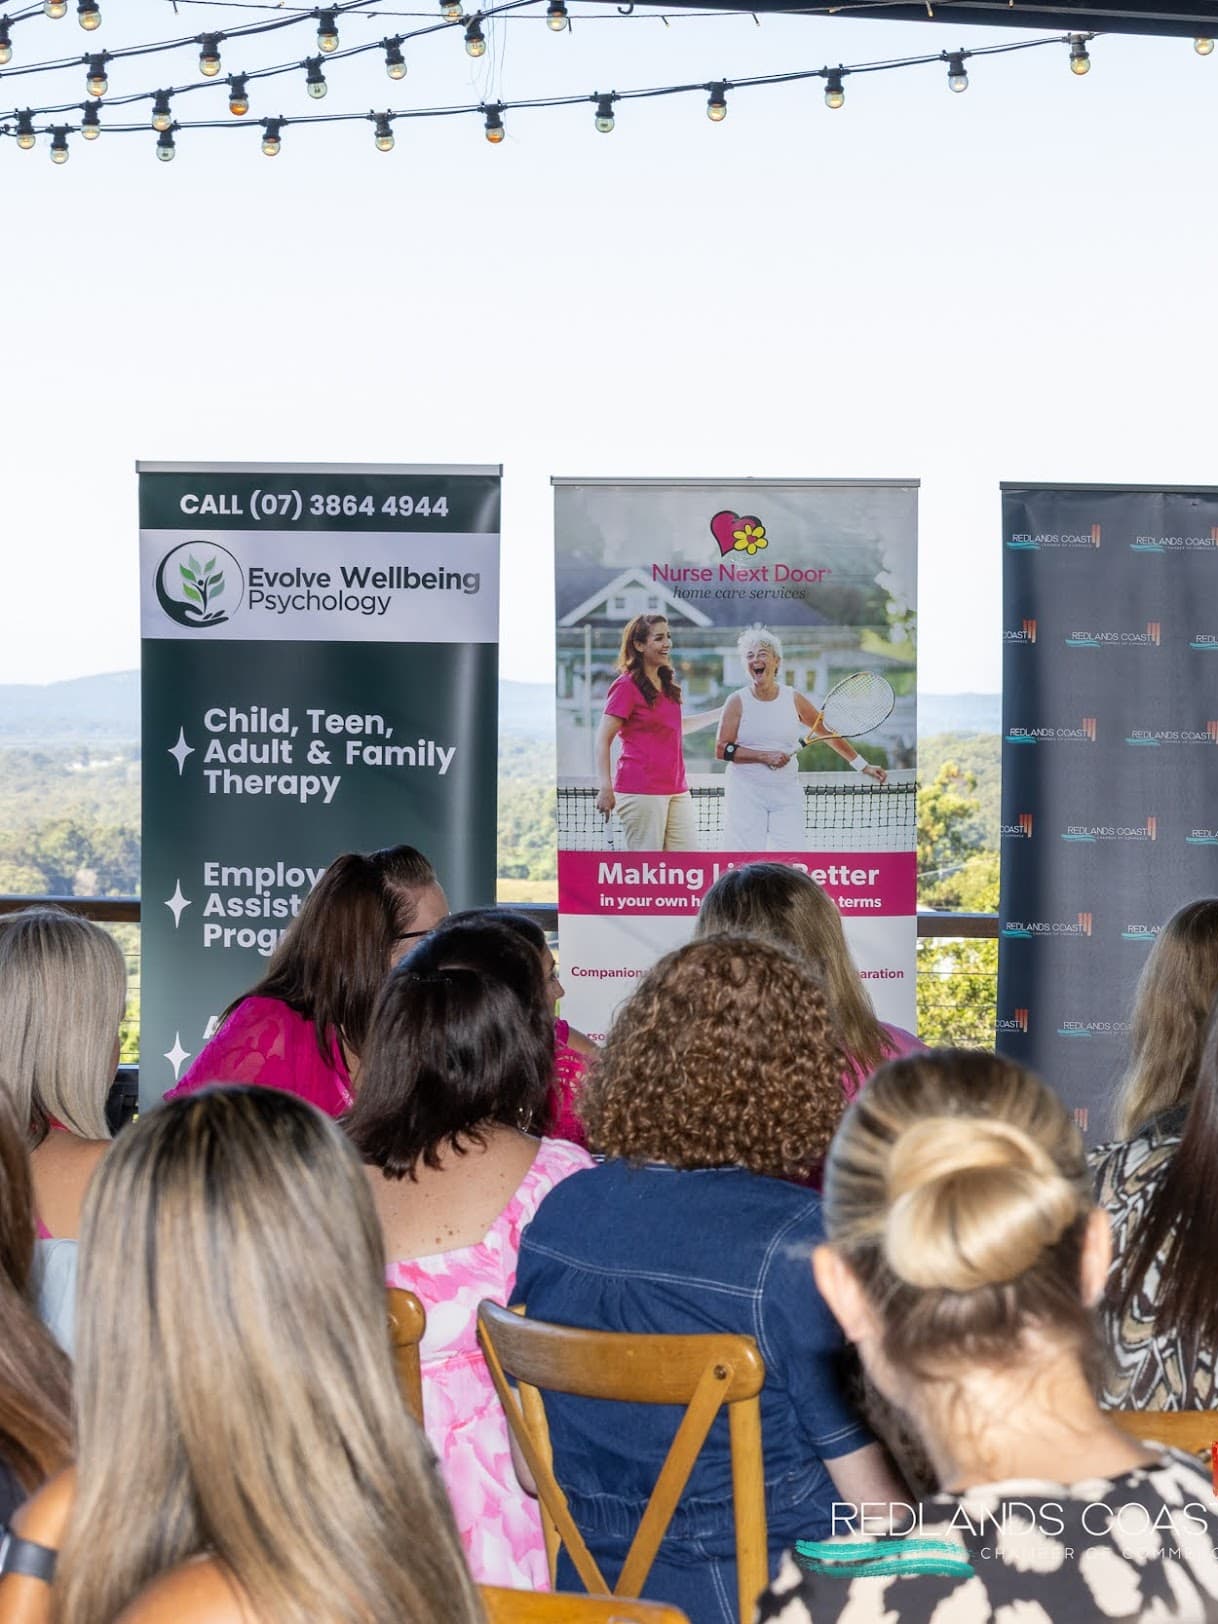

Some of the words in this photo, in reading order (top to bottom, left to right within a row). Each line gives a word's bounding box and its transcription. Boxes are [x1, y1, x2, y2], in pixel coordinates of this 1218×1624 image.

[179, 494, 243, 516] CALL
[249, 489, 302, 520] (07)
[310, 494, 375, 517] 3864
[381, 495, 449, 518] 4944
[1012, 533, 1058, 543] REDLANDS
[1060, 534, 1092, 544] COAST
[1136, 536, 1183, 546] REDLANDS
[1185, 537, 1217, 547] COAST
[248, 567, 331, 588] Evolve
[340, 566, 481, 595] Wellbeing
[652, 563, 713, 582] Nurse
[719, 563, 769, 583] Next
[774, 564, 827, 583] Door
[673, 585, 712, 599] home
[715, 588, 746, 600] care
[750, 586, 807, 600] services
[249, 590, 392, 615] Psychology
[1072, 631, 1119, 641] REDLANDS
[1121, 632, 1152, 642] COAST
[203, 706, 299, 737] Child,
[306, 709, 394, 738] Teen,
[1009, 728, 1054, 738] REDLANDS
[1056, 729, 1088, 738] COAST
[1132, 730, 1179, 740] REDLANDS
[1181, 731, 1212, 741] COAST
[203, 738, 293, 765] Adult
[307, 739, 332, 765] &
[346, 739, 457, 775] Family
[203, 769, 341, 804] Therapy
[1067, 826, 1115, 836] REDLANDS
[1117, 827, 1147, 836] COAST
[597, 862, 704, 889] Making
[600, 894, 614, 907] in
[616, 896, 653, 910] your
[655, 896, 688, 908] own
[838, 895, 882, 908] terms
[1006, 922, 1049, 932] REDLANDS
[1051, 923, 1083, 933] COAST
[1063, 1021, 1110, 1032] REDLANDS
